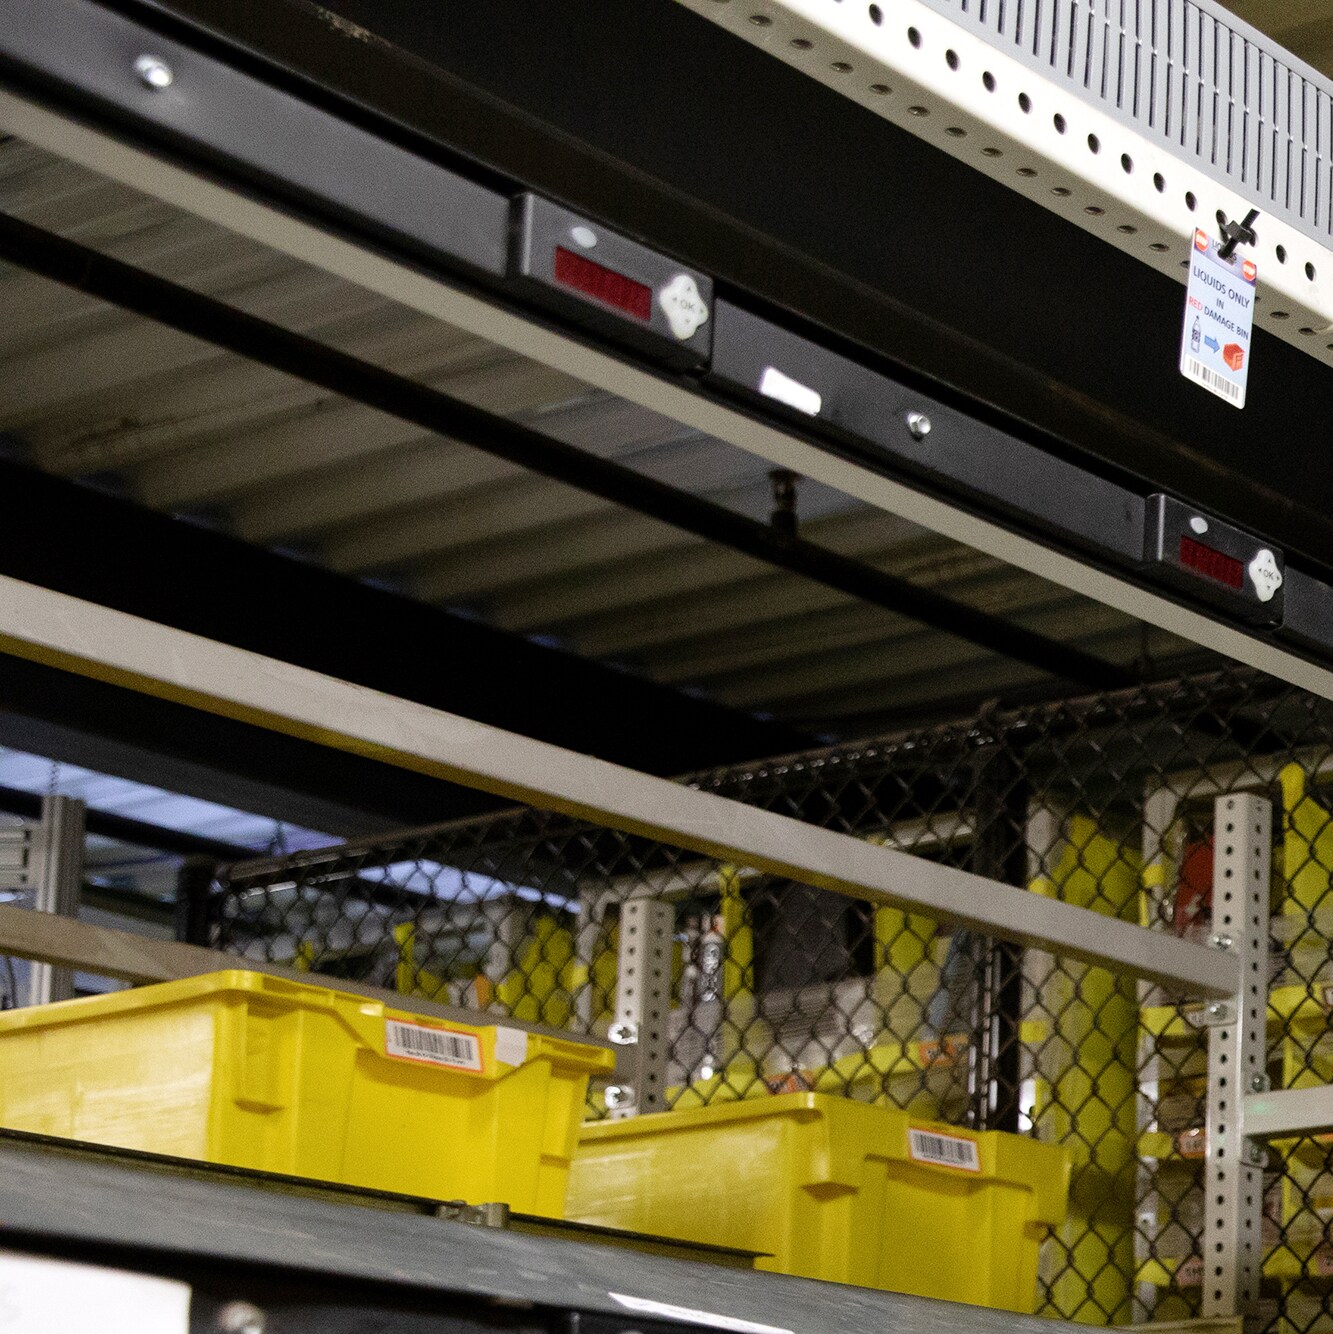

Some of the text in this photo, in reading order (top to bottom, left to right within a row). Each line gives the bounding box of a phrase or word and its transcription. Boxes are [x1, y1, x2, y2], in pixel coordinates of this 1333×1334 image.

[1193, 265, 1251, 309] LIQUIDS ONLY
[1216, 298, 1225, 310] IN
[1189, 296, 1250, 341] RED DAMAGE BIN
